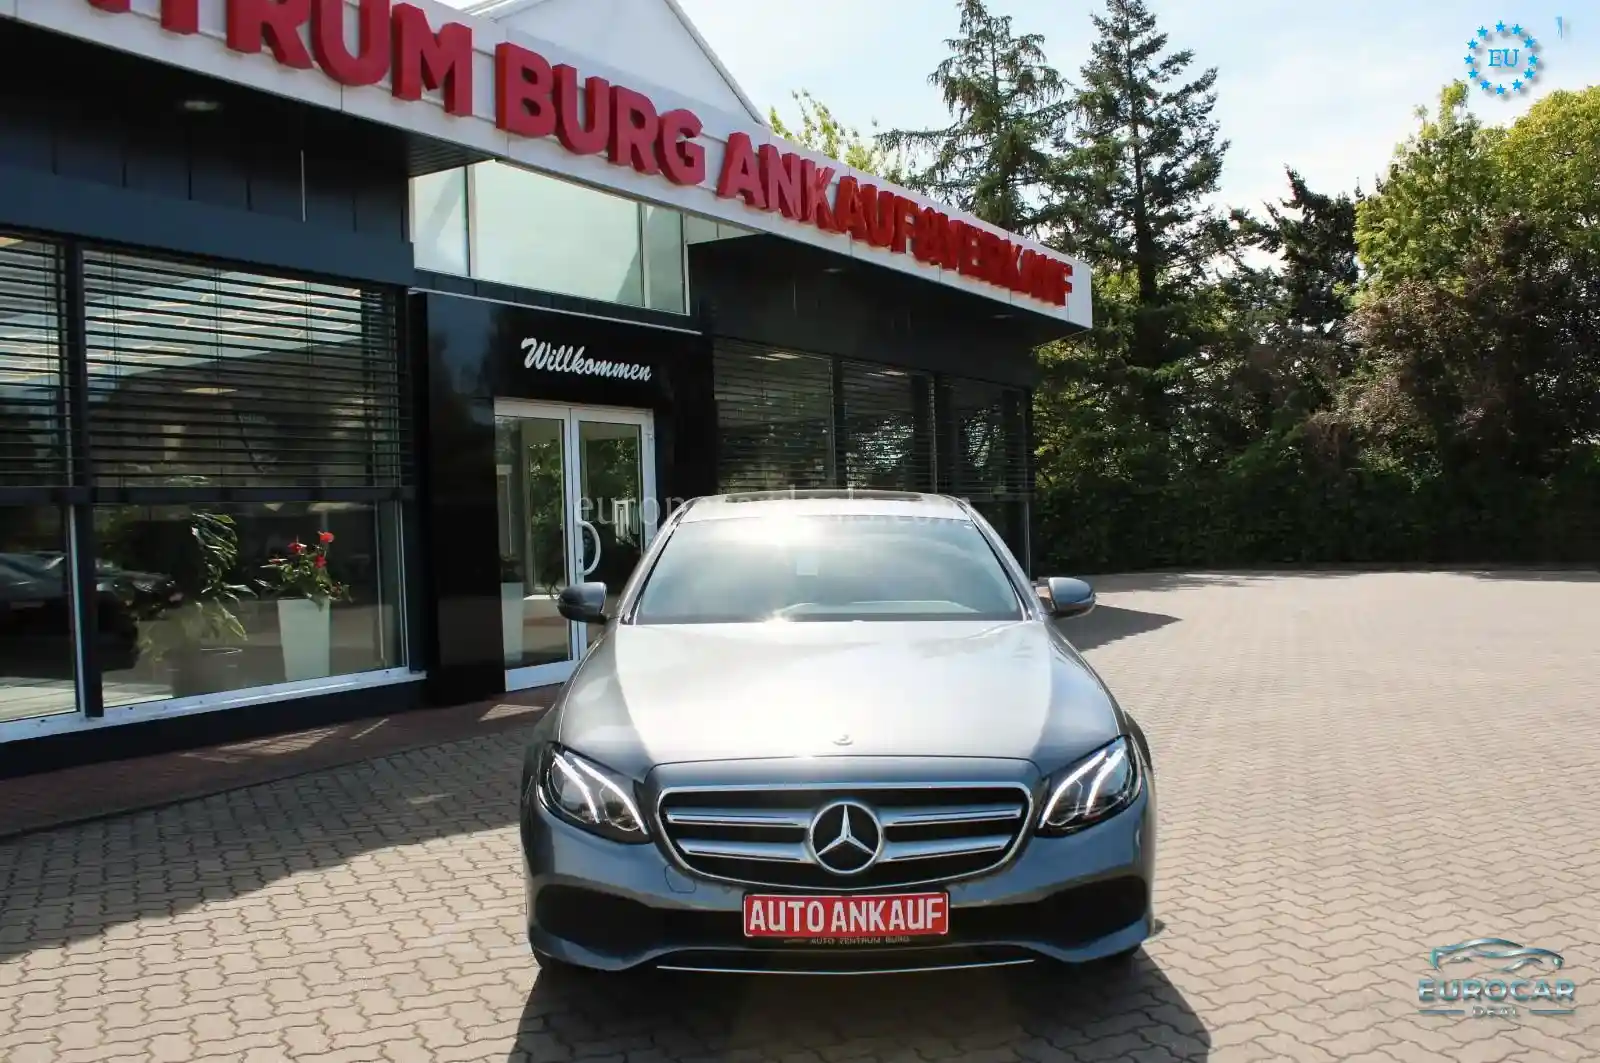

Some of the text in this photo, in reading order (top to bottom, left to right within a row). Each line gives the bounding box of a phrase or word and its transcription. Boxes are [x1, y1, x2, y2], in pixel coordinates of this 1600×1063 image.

[495, 42, 705, 186] BURG
[521, 337, 652, 382] Willkommen
[749, 897, 943, 932] AUTO ANKAUF
